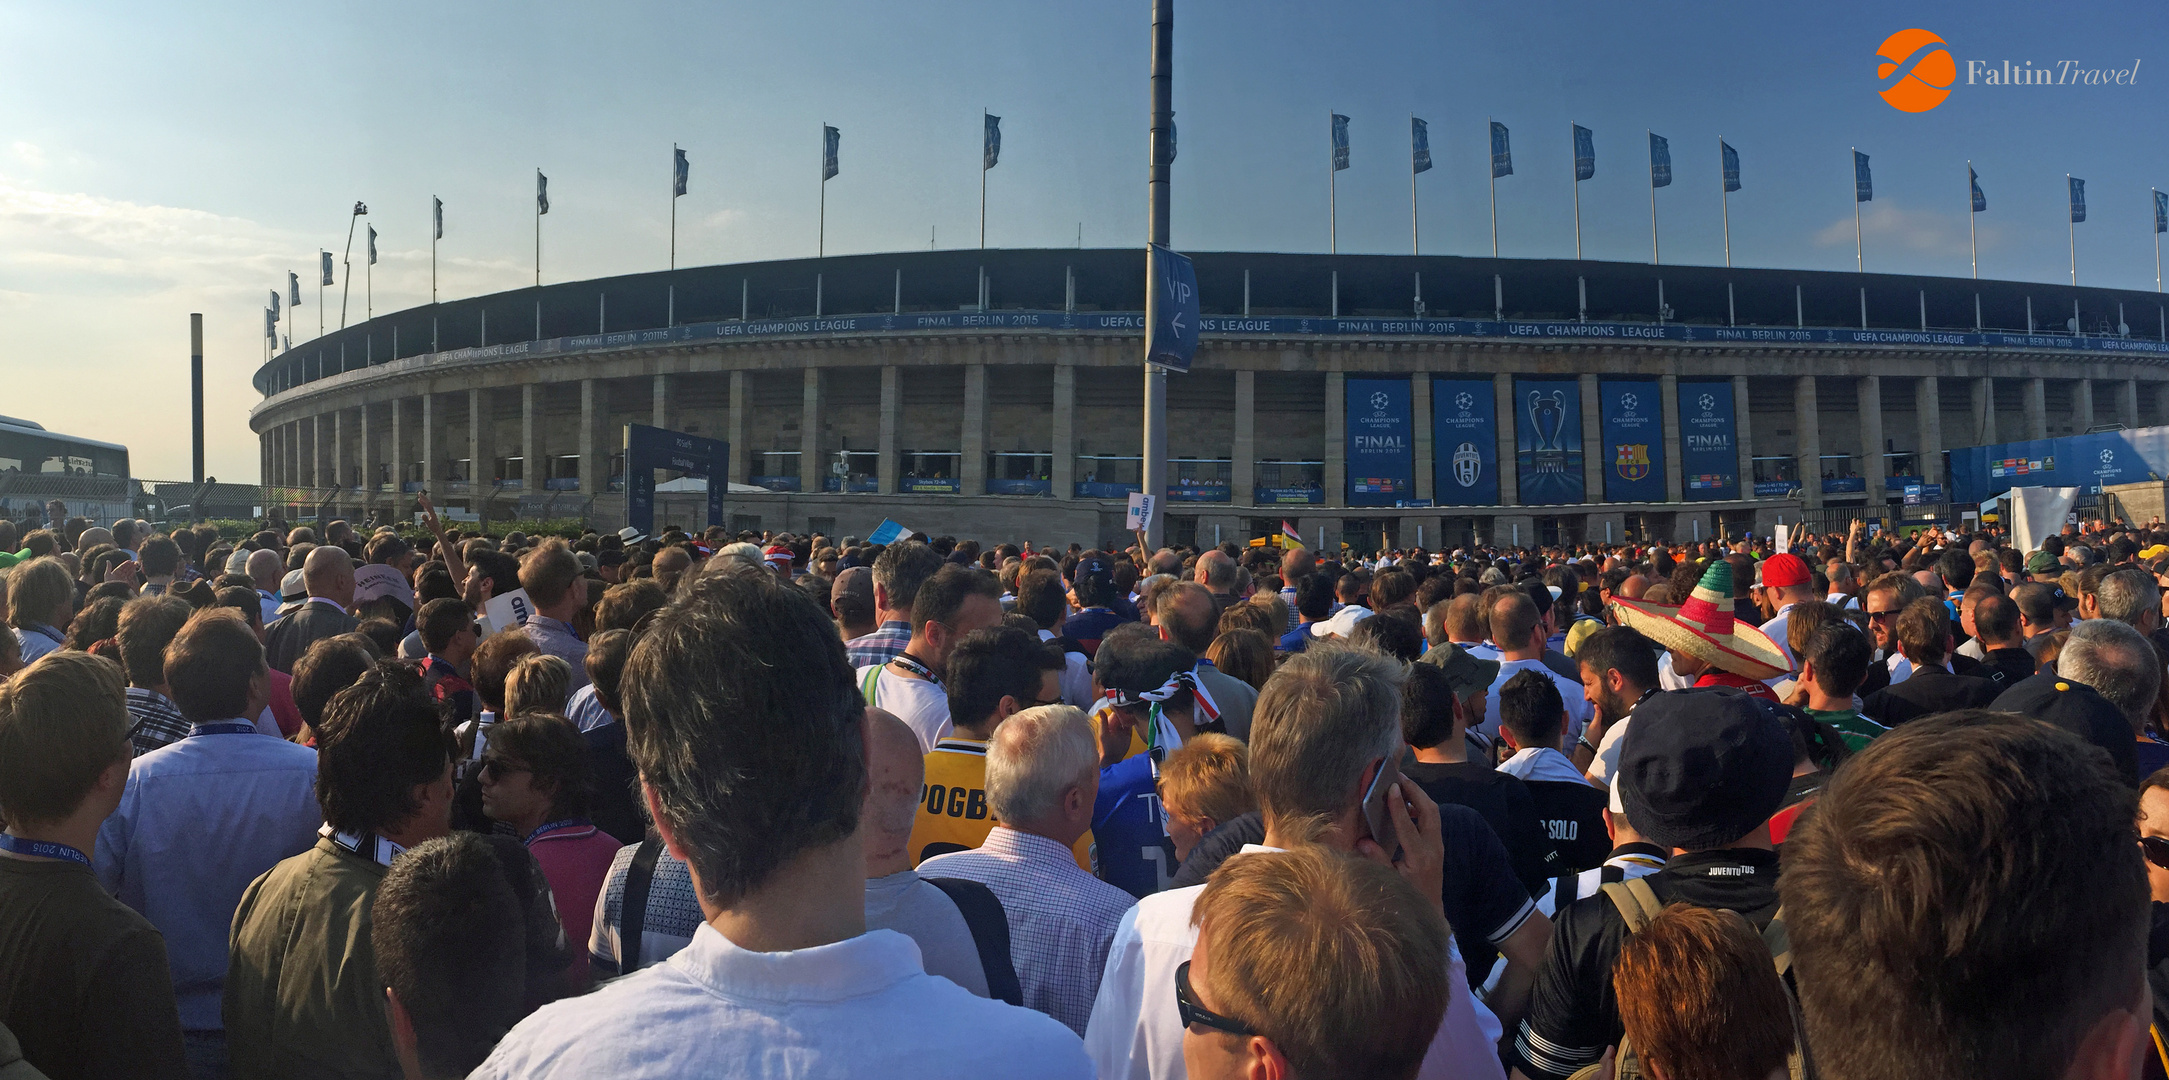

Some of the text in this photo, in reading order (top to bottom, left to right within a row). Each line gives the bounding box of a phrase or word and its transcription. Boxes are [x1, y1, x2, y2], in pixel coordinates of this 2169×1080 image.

[1166, 277, 1191, 304] VIP
[917, 314, 1039, 326] FINAL BERLIN 2015
[1100, 317, 1133, 328] UEFA
[1221, 320, 1271, 331] LEAGUE
[717, 319, 856, 336] UEFA CHAMPIONS LEAGUE
[1338, 321, 1456, 333] FINAL BERLIN 2015
[1509, 324, 1666, 338] UEFA CHAMPIONS LEAGUE
[607, 332, 637, 345] BERLIN
[1716, 329, 1812, 341] FINAL BERLIN 2015
[1853, 332, 1966, 345] UEFA CHAMPIONS LEAGUE
[2003, 336, 2073, 348] FINAL BERLIN 2015
[2102, 341, 2120, 350] UEFA
[2120, 341, 2158, 351] CHAMPIONS
[1354, 435, 1406, 449] FINAL
[1687, 434, 1731, 447] FINAL
[2093, 468, 2122, 476] CHAMPIONS
[921, 783, 997, 821] OGB
[535, 822, 558, 835] BERLIN
[1548, 819, 1578, 841] SOLO
[33, 843, 89, 865] BERLIN 2015
